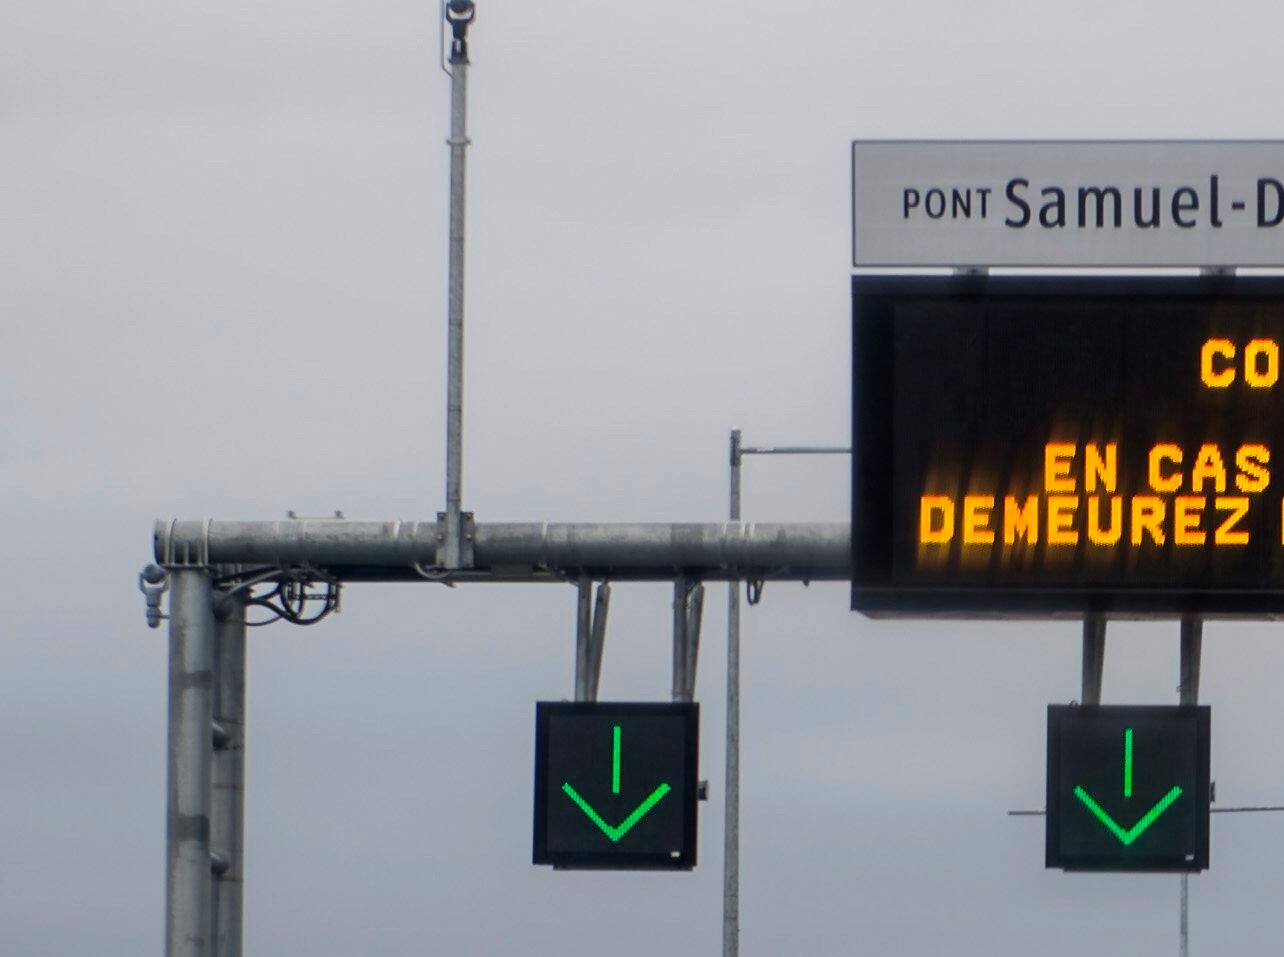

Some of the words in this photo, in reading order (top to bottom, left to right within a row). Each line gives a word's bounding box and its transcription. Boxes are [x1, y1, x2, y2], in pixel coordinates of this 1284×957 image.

[903, 188, 992, 220] PONT
[1044, 441, 1118, 494] EN
[1148, 442, 1271, 494] CAS
[919, 495, 1250, 547] DEMEUREZ
